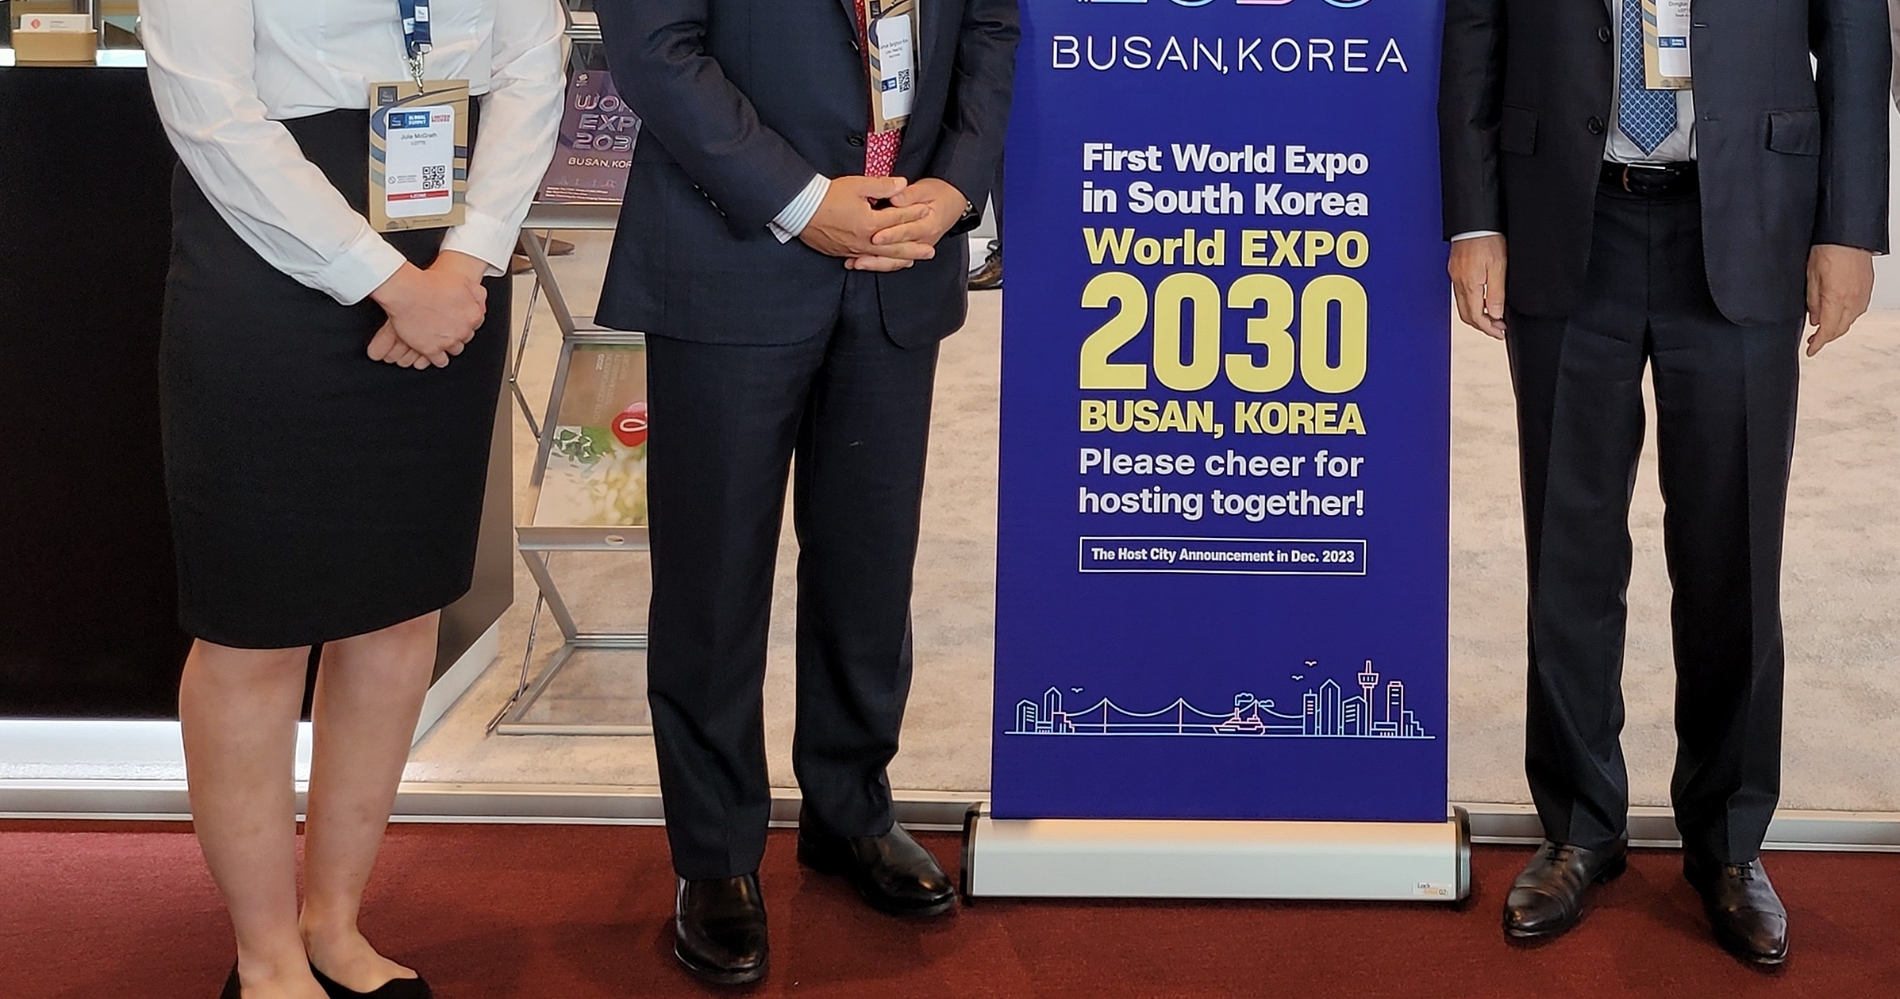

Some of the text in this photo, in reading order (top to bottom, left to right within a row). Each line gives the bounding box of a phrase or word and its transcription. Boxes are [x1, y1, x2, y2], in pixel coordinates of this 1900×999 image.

[1052, 35, 1409, 75] BUSAN, KOREA
[578, 113, 642, 132] EXP
[572, 131, 636, 152] 203
[1083, 142, 1369, 182] First World Expo
[1082, 181, 1369, 216] in South Korea
[1082, 227, 1369, 268] World EXPO
[1079, 271, 1368, 393] 2030
[1079, 400, 1367, 439] BUSAN, KOREA
[1079, 447, 1364, 478] Please cheer for
[1079, 486, 1364, 522] hosting together!
[1091, 548, 1354, 563] The Host City Announcement in Dec. 2023
